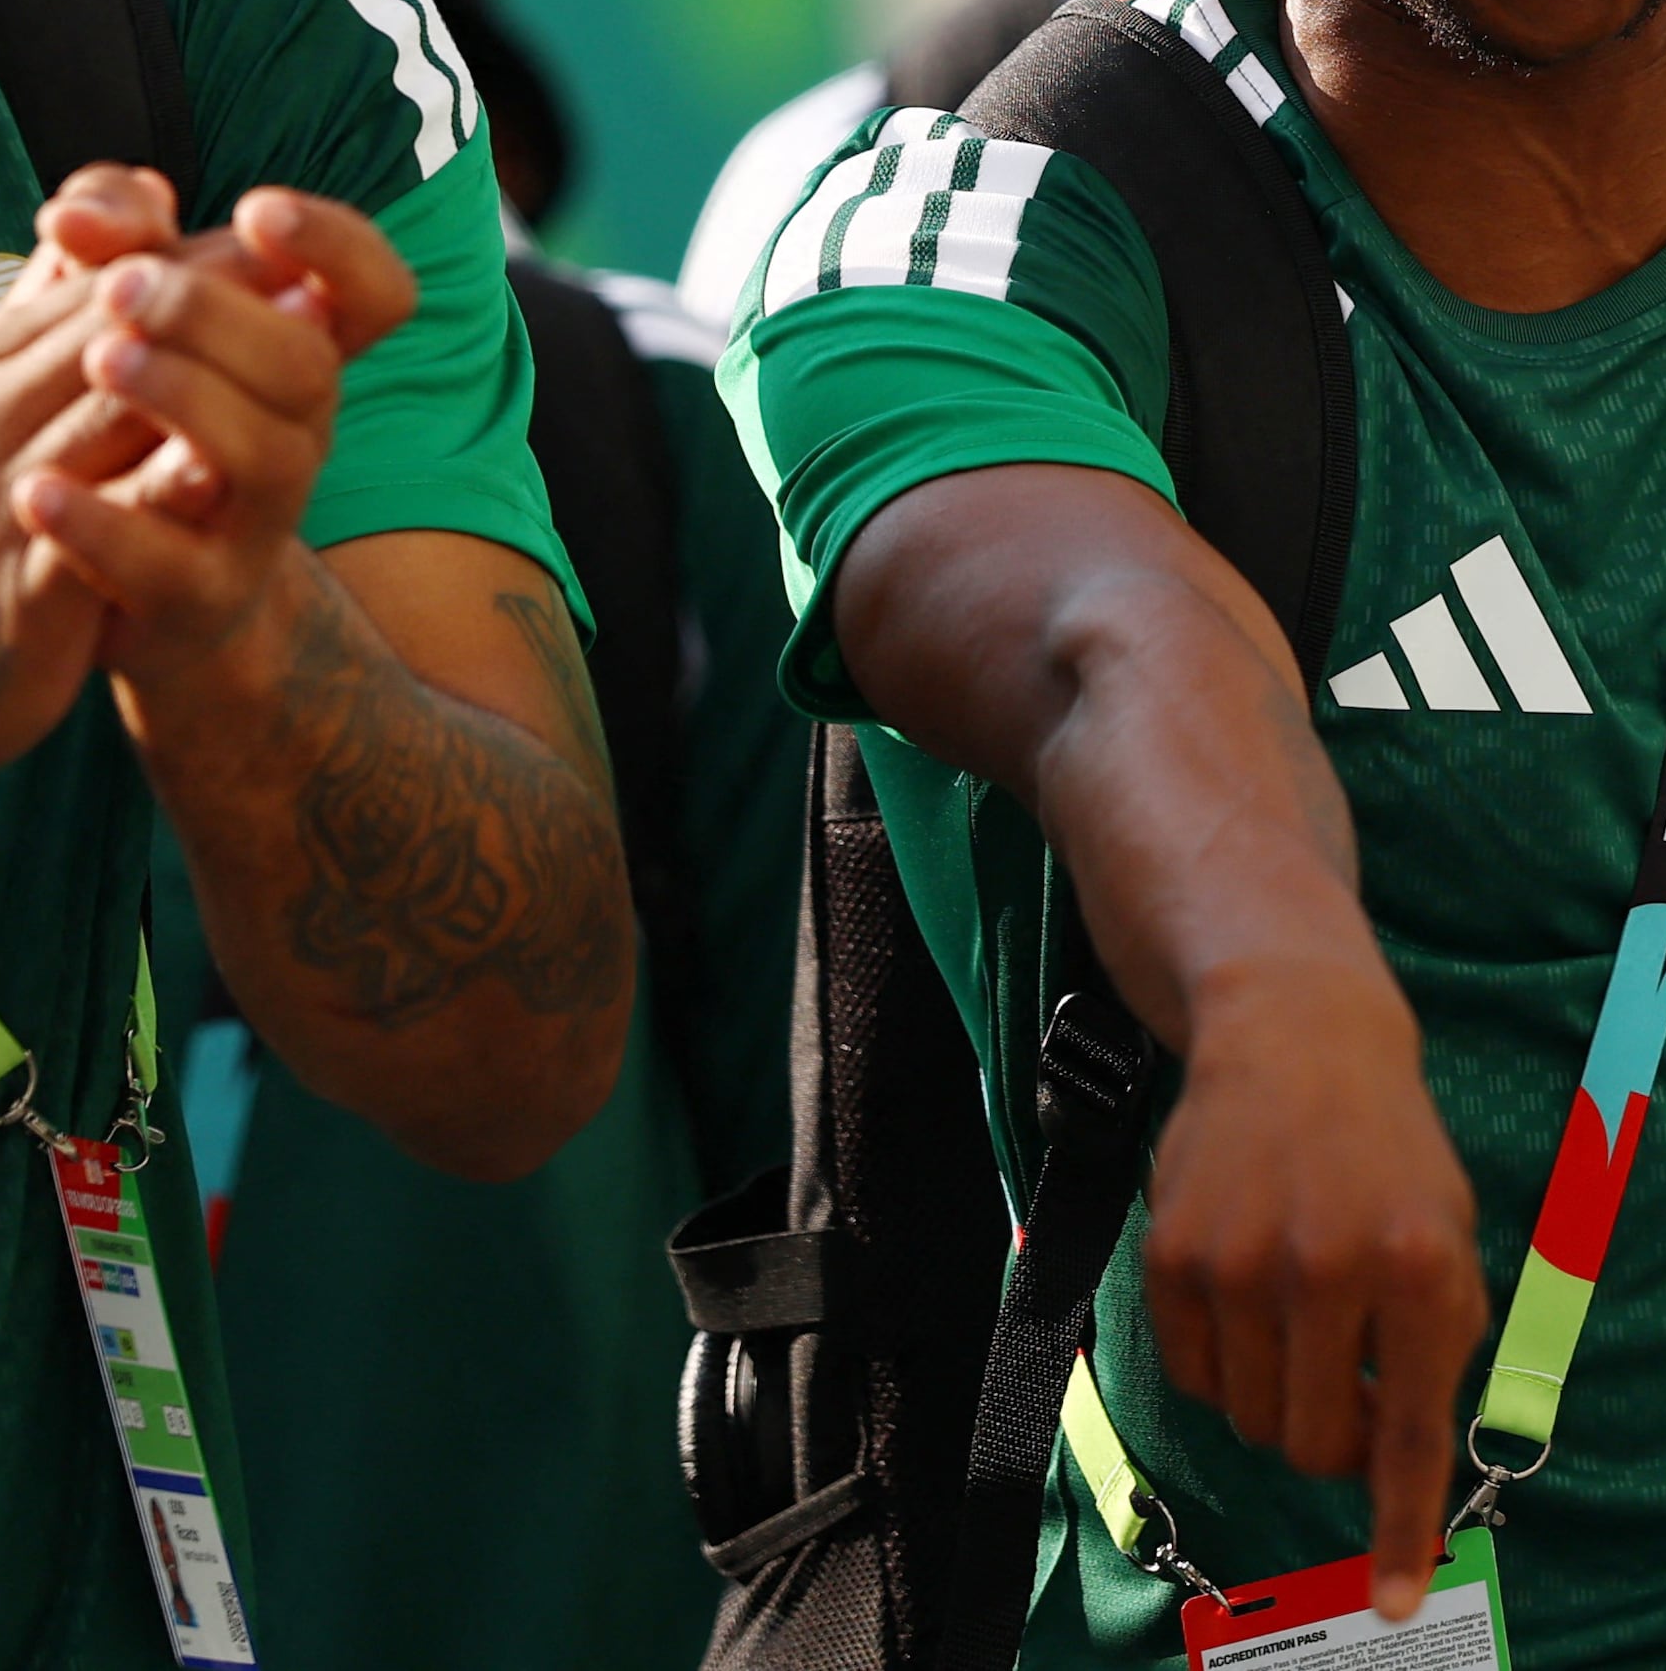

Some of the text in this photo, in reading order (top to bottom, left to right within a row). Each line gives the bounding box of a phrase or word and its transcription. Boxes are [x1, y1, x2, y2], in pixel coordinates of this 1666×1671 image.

[1369, 1635, 1395, 1646] person
[1396, 1626, 1424, 1639] granted
[1439, 1610, 1486, 1627] Accreditation
[1423, 1622, 1473, 1640] Internationale
[1207, 1630, 1327, 1668] ACCREDITATION PASS
[1403, 1654, 1418, 1663] only
[1419, 1645, 1455, 1659] permitted
[1467, 1637, 1490, 1646] access
[1430, 1639, 1443, 1647] and
[1409, 1653, 1456, 1669] Accreditation
[1478, 1644, 1491, 1652] The
[1461, 1659, 1474, 1667] any
